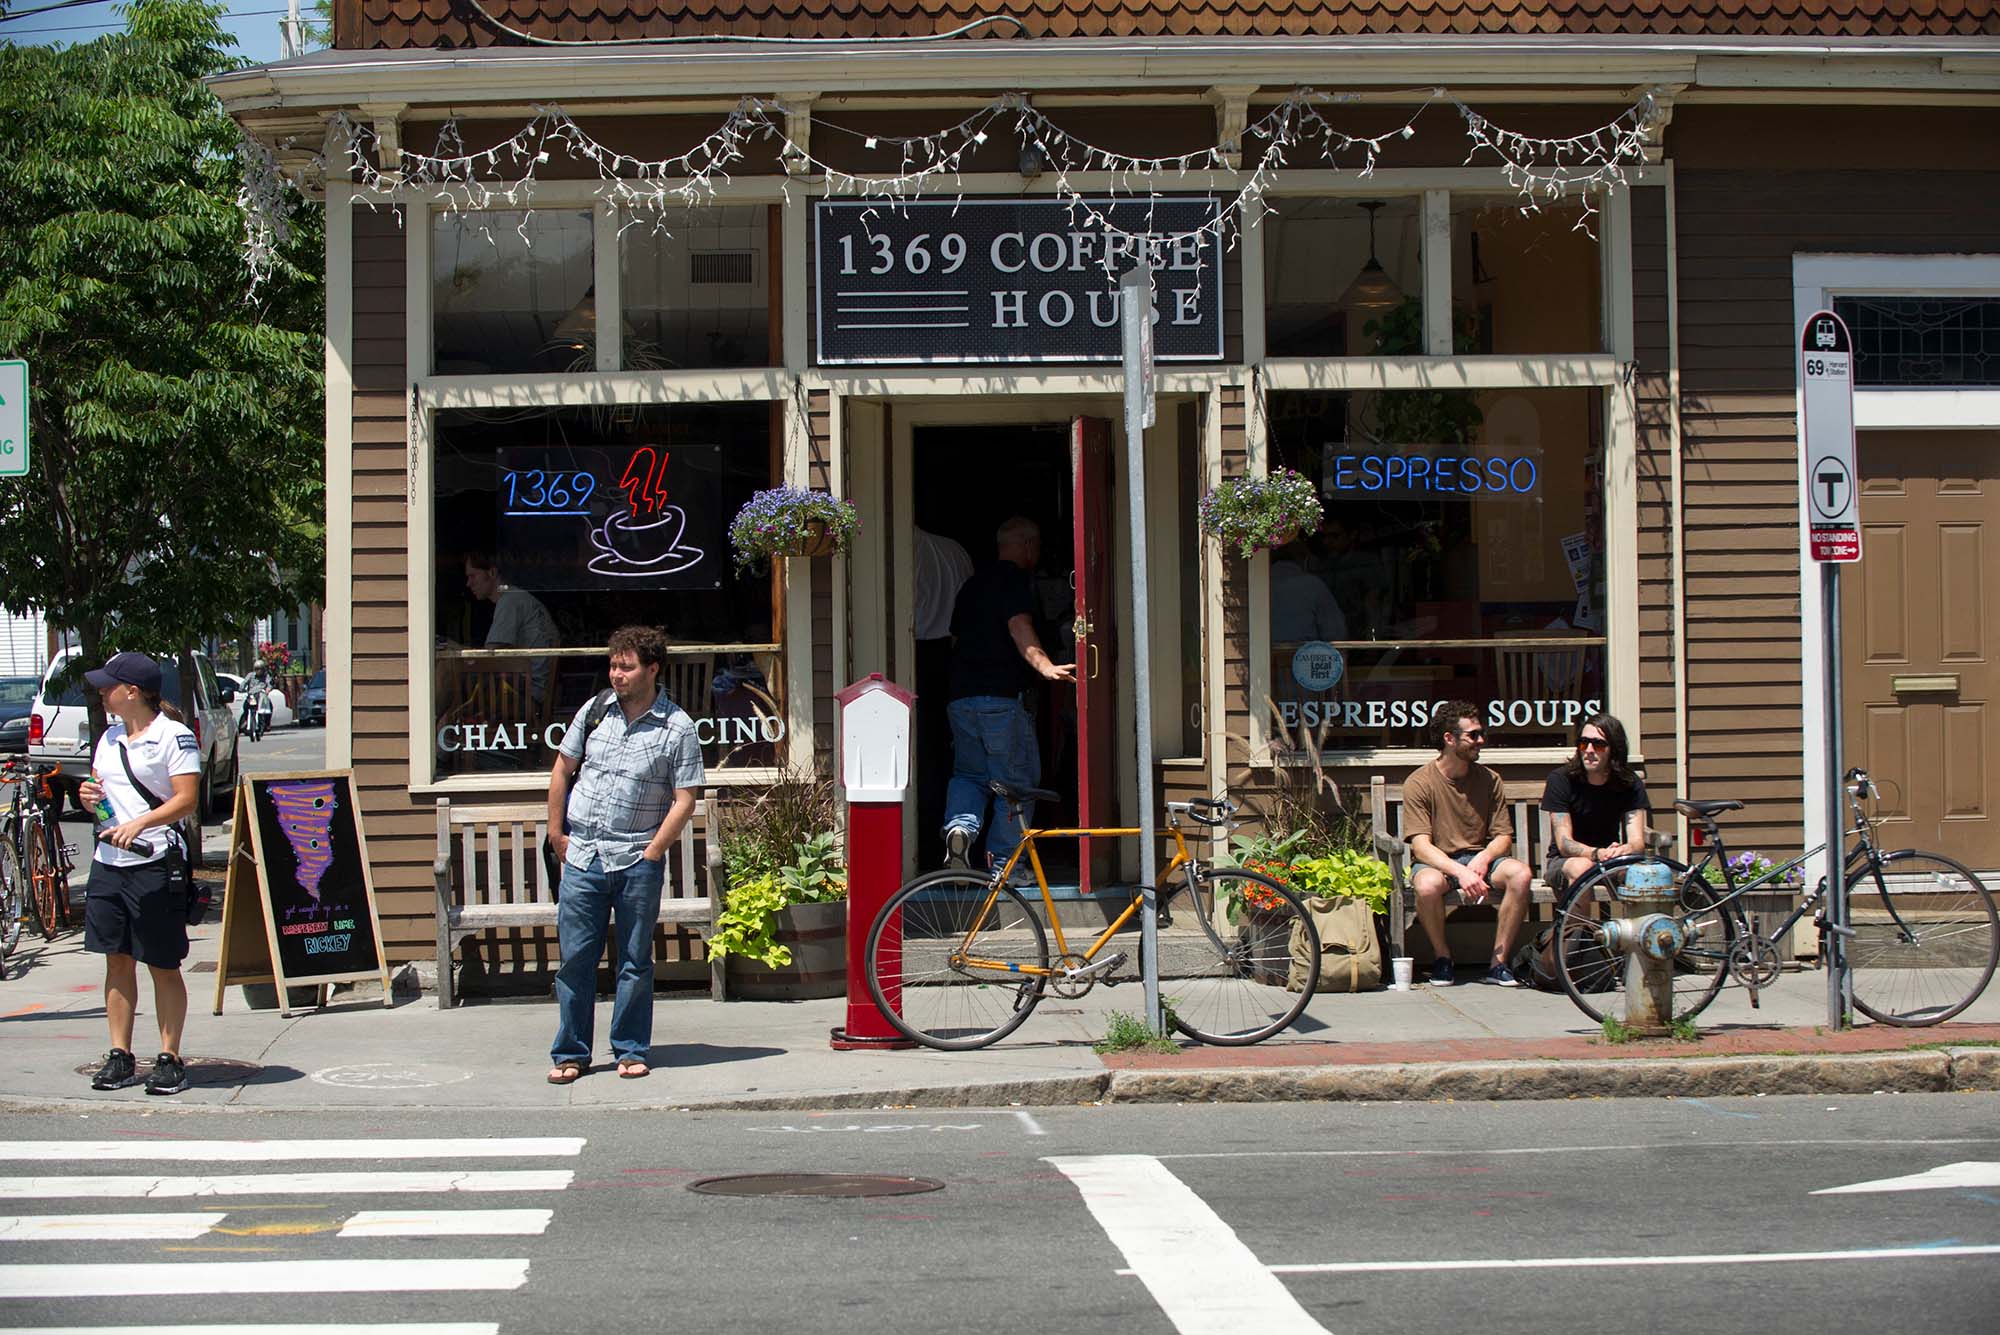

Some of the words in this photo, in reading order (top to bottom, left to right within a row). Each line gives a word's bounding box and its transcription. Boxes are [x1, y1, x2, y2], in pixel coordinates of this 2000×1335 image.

[838, 232, 967, 275] 1369
[990, 231, 1202, 273] COFFEE
[1807, 359, 1824, 376] 69
[1335, 455, 1537, 493] ESPRESSO
[503, 468, 596, 508] 1369
[1818, 472, 1844, 508] T
[1821, 532, 1857, 542] STANDING
[1311, 662, 1332, 671] Local
[1311, 671, 1330, 680] First
[1487, 699, 1601, 728] SOUPS
[334, 919, 355, 930] LIME
[304, 934, 351, 954] RICKEY
